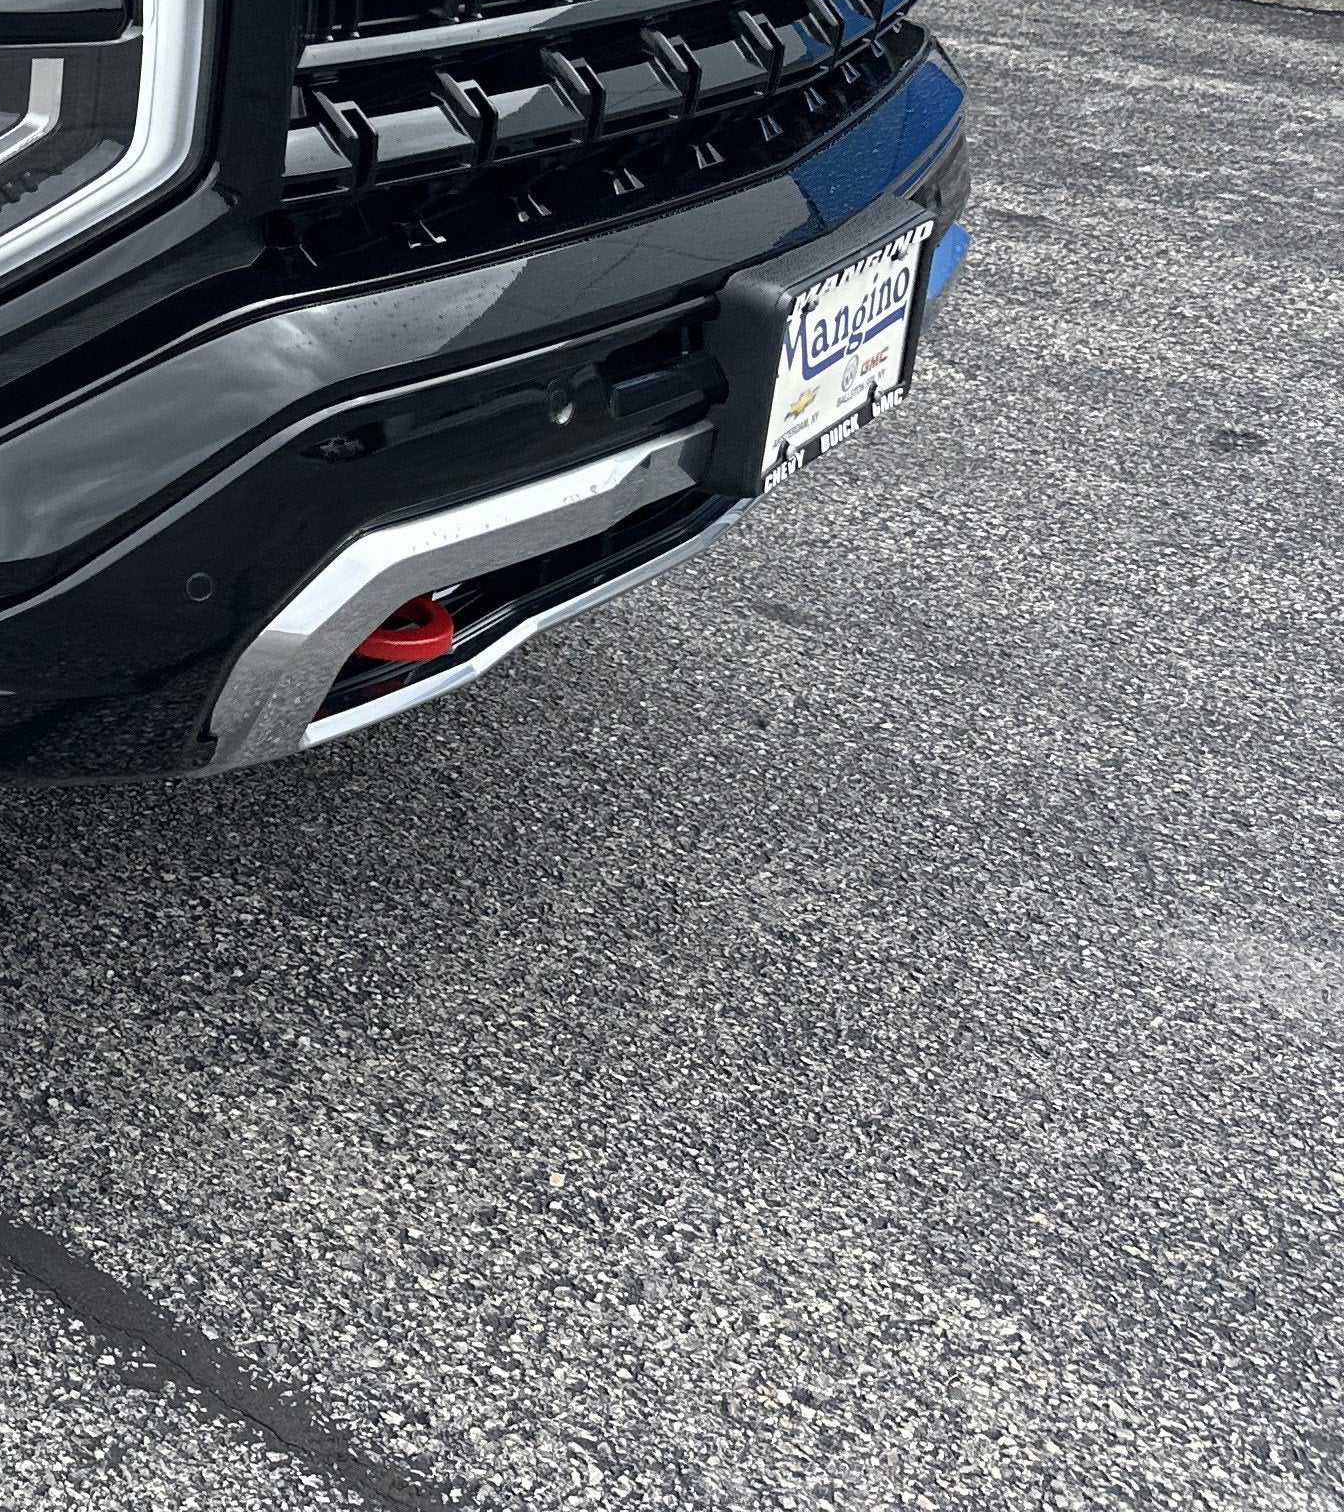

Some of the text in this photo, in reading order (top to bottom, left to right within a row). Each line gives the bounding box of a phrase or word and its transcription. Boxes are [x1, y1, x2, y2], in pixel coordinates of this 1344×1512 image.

[783, 266, 910, 381] Mangino
[860, 345, 889, 376] GMC
[764, 387, 904, 494] CHEVY BUICK GMC
